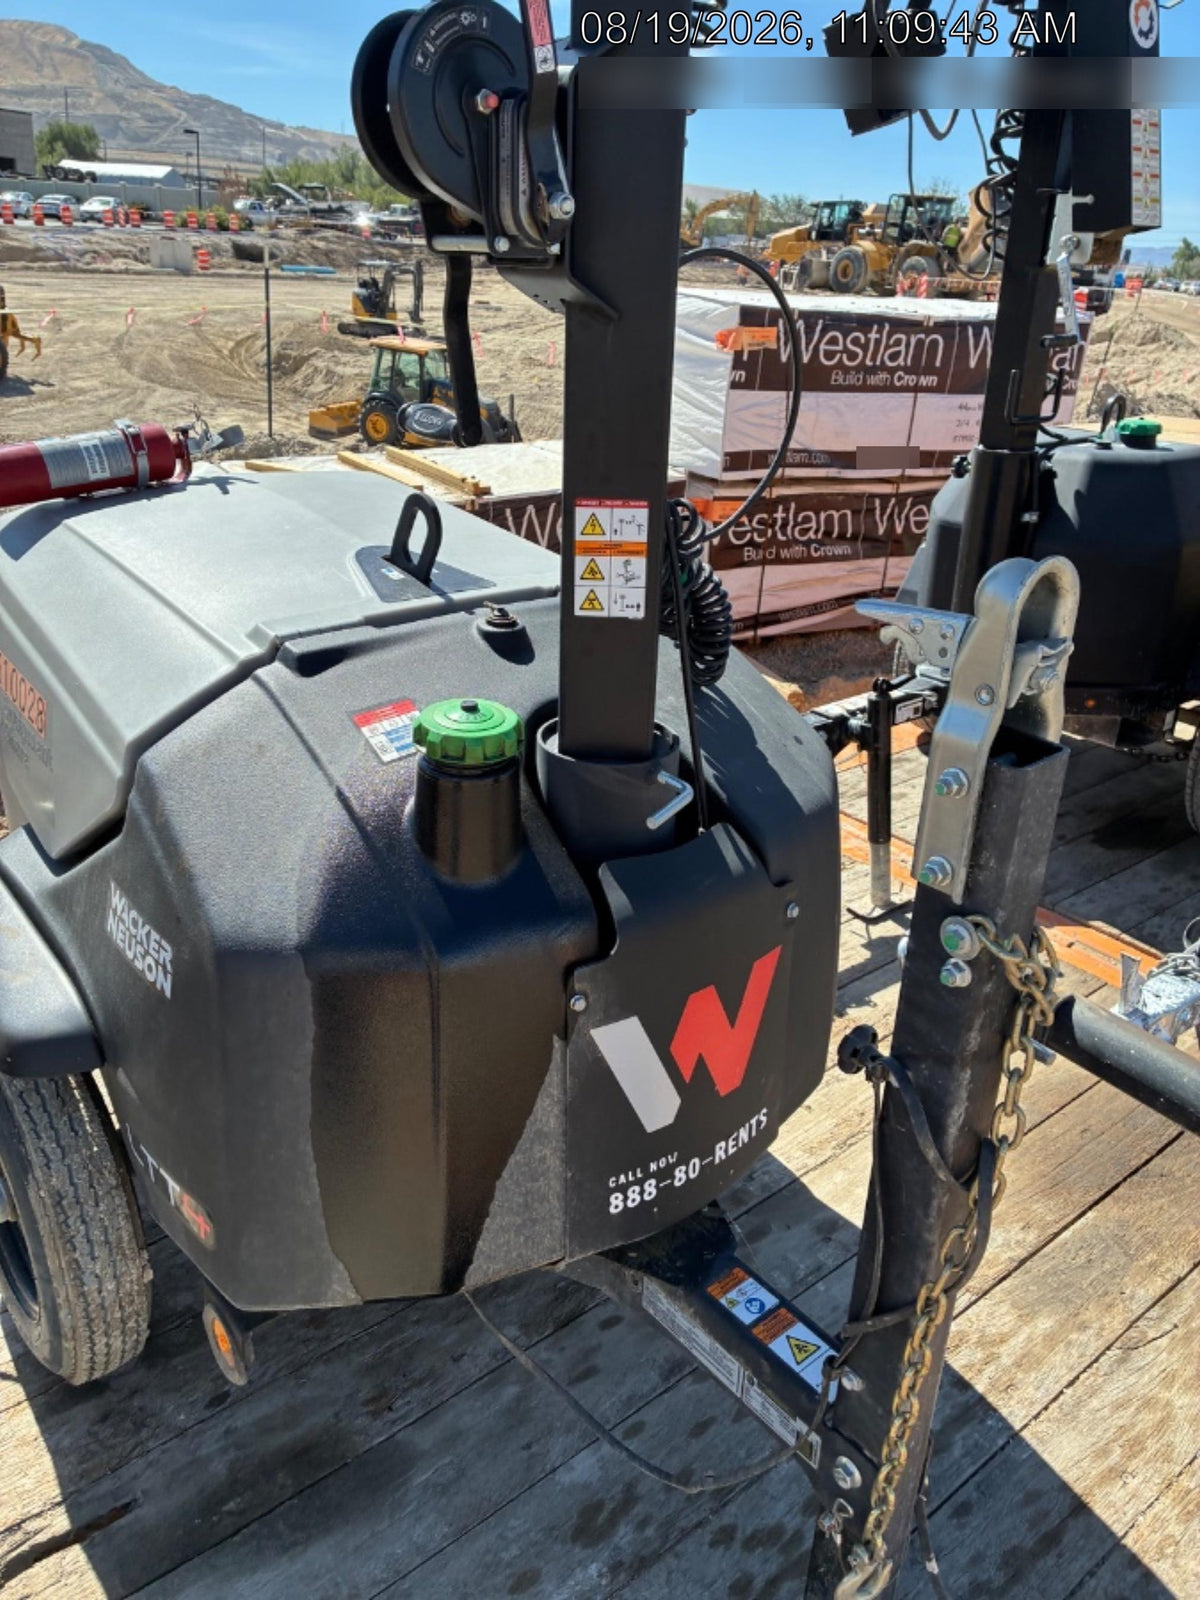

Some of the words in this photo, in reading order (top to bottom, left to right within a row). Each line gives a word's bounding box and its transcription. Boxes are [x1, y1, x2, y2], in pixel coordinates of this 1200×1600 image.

[778, 318, 944, 368] Westlam
[830, 369, 863, 387] Build
[866, 370, 892, 387] with
[893, 371, 939, 388] Crown
[711, 502, 852, 546] estlam
[779, 543, 808, 560] with
[810, 542, 851, 557] Crown
[108, 879, 173, 974] WACKER
[107, 907, 172, 1000] NEUSON
[608, 1106, 768, 1214] 888-80-RENTS
[608, 1167, 644, 1188] CALL
[649, 1151, 679, 1173] NOW
